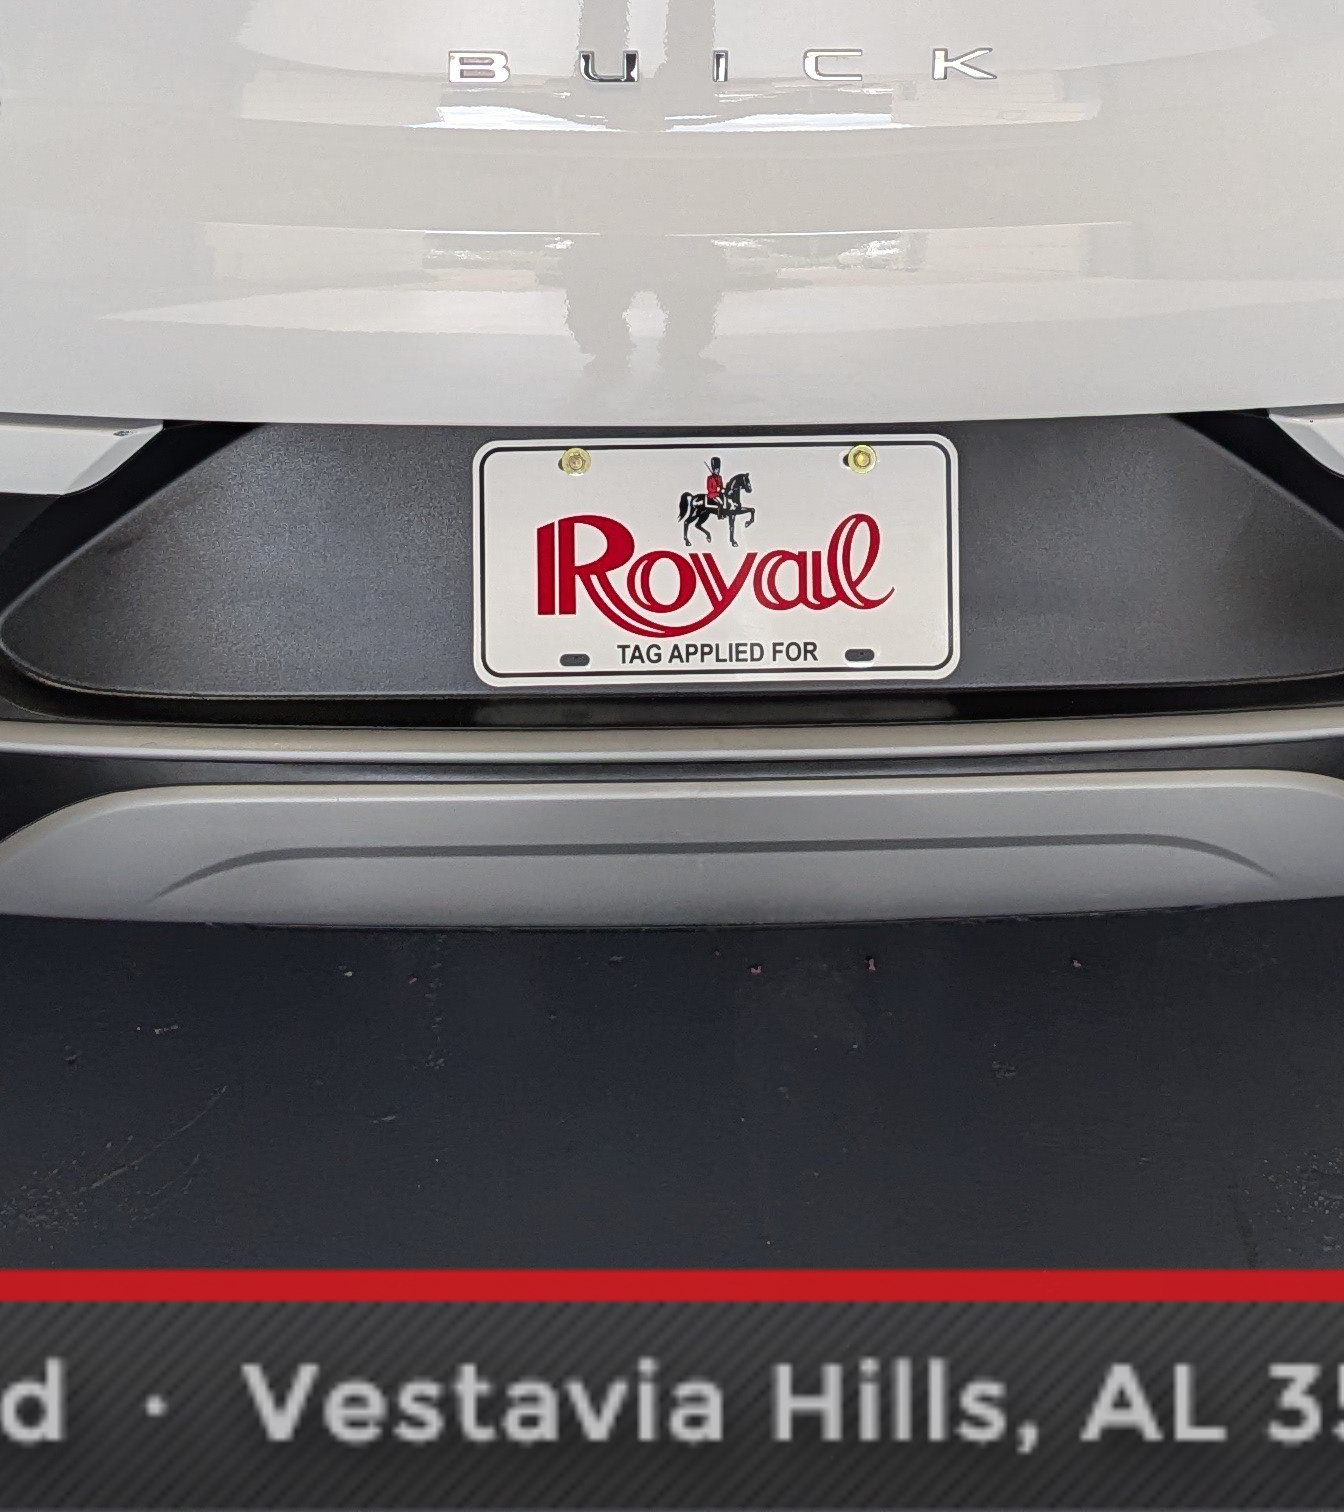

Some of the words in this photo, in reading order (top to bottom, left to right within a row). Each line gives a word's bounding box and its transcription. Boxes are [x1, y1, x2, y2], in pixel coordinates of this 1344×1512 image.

[448, 47, 998, 83] BUICK
[536, 513, 896, 638] Royal
[616, 644, 662, 665] TAG
[668, 642, 766, 664] APPLIED
[771, 641, 818, 663] FOR
